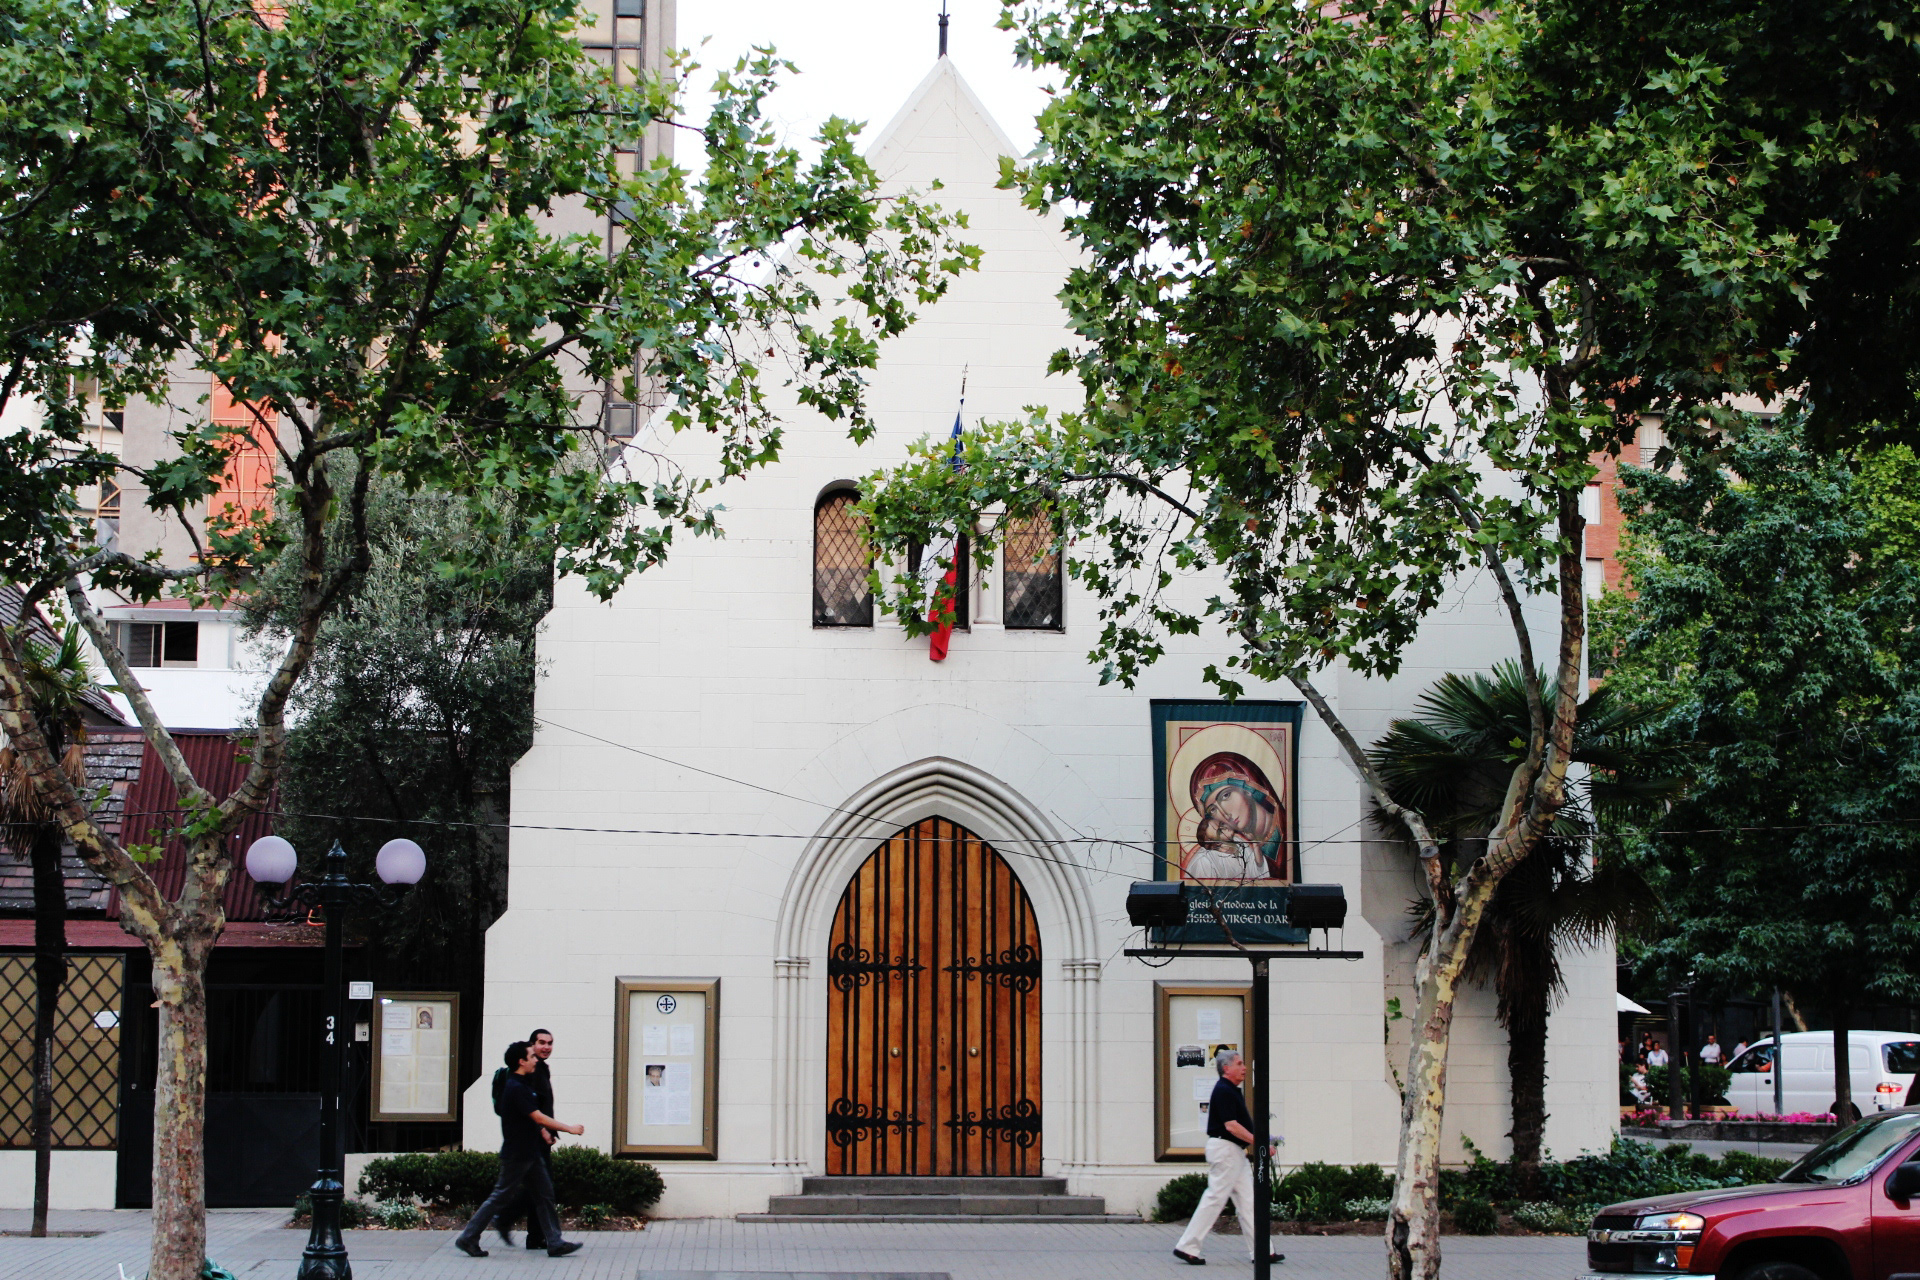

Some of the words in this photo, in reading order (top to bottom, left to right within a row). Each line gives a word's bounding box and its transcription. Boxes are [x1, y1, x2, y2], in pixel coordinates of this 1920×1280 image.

[1257, 900, 1268, 909] de
[1269, 899, 1278, 910] la
[1222, 914, 1261, 924] VIRGEN
[1263, 914, 1289, 924] MAR
